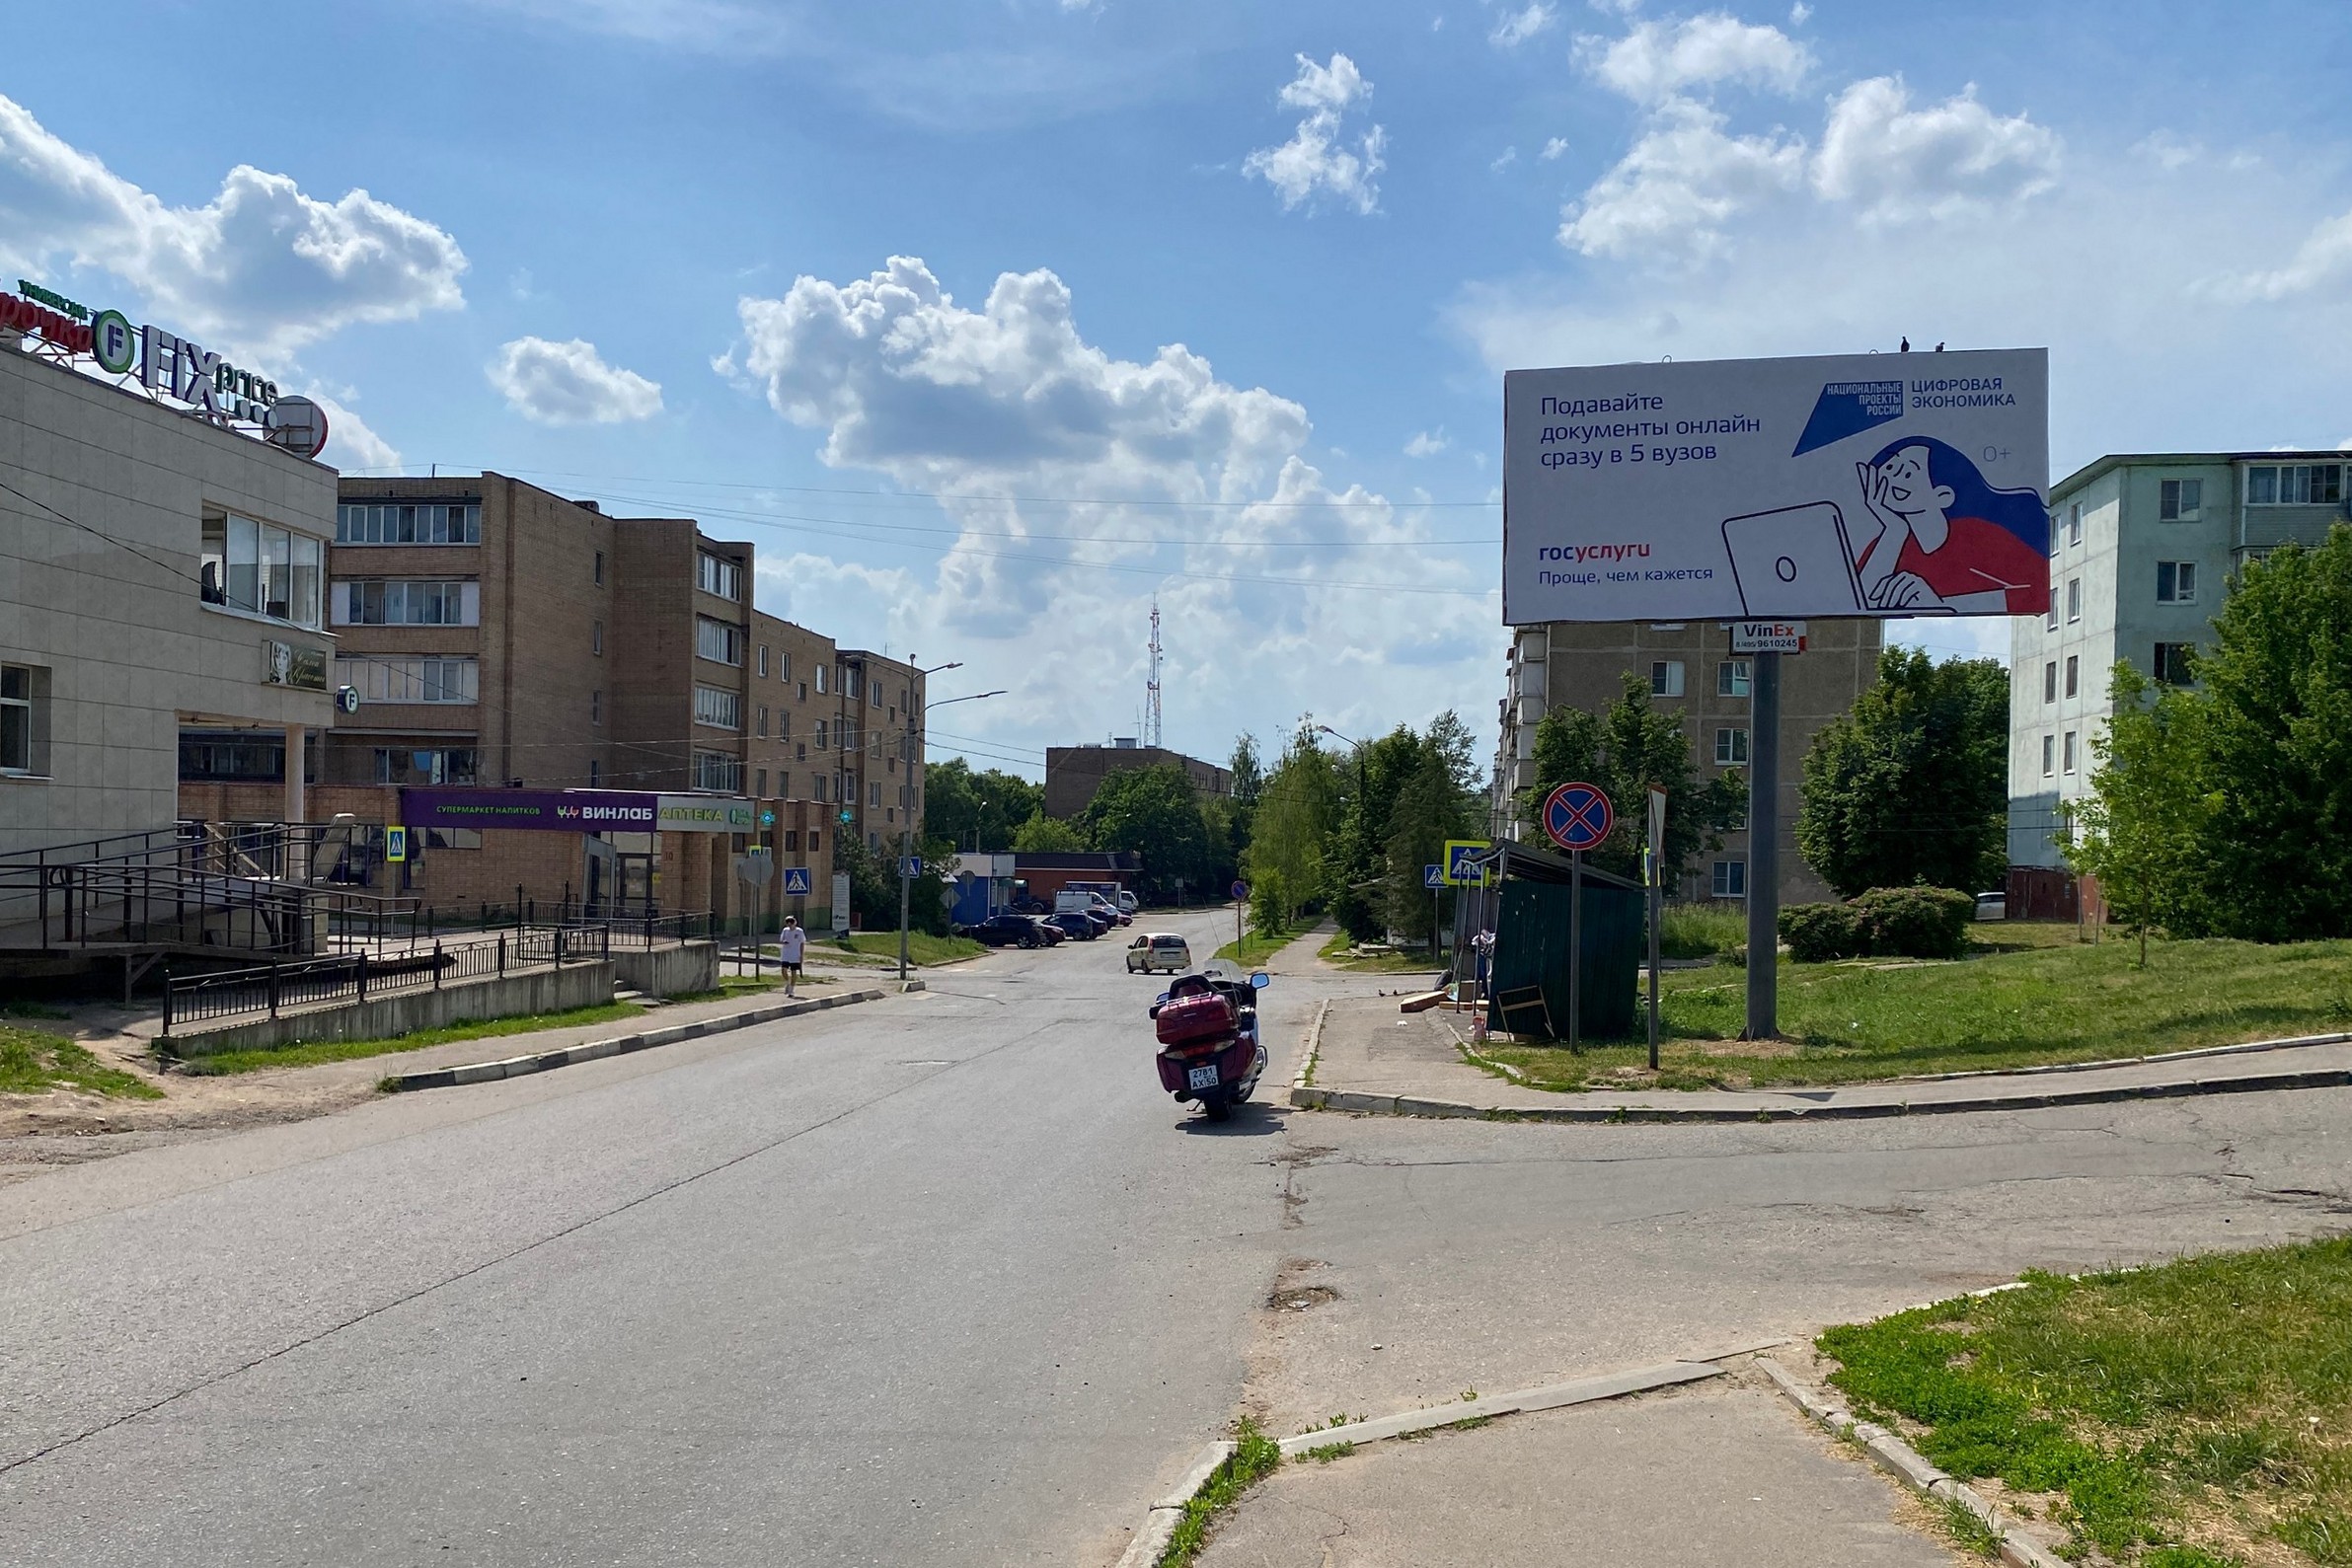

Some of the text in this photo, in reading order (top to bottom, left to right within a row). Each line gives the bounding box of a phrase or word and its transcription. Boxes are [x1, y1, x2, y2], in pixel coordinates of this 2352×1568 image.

[108, 325, 123, 357] F
[1827, 382, 1902, 395] НАЦИОНАЛЬНЫЕ
[1912, 378, 2002, 394] ЦИФРОВАЯ
[1542, 393, 1663, 417] Подавайте
[1859, 395, 1902, 406] ПРОЕКТЫ
[1912, 394, 2016, 408] ЭКОНОМИКА
[1866, 405, 1902, 415] РОССИИ
[1541, 414, 1760, 443] документы онлайн
[1541, 444, 1717, 470] сразу в 5 вузов
[1983, 445, 2011, 463] 0+
[1539, 543, 1650, 563] госуслуги
[1539, 567, 1713, 587] Проще, чем кажется
[1744, 624, 1795, 636] VinEx
[1757, 638, 1798, 647] 9610245
[436, 805, 541, 815] СУПЕРМАРКЕТ НАПИТКОВ
[658, 807, 723, 822] АПТЕКА
[1192, 1068, 1213, 1078] 2781
[1206, 1077, 1217, 1085] 50
